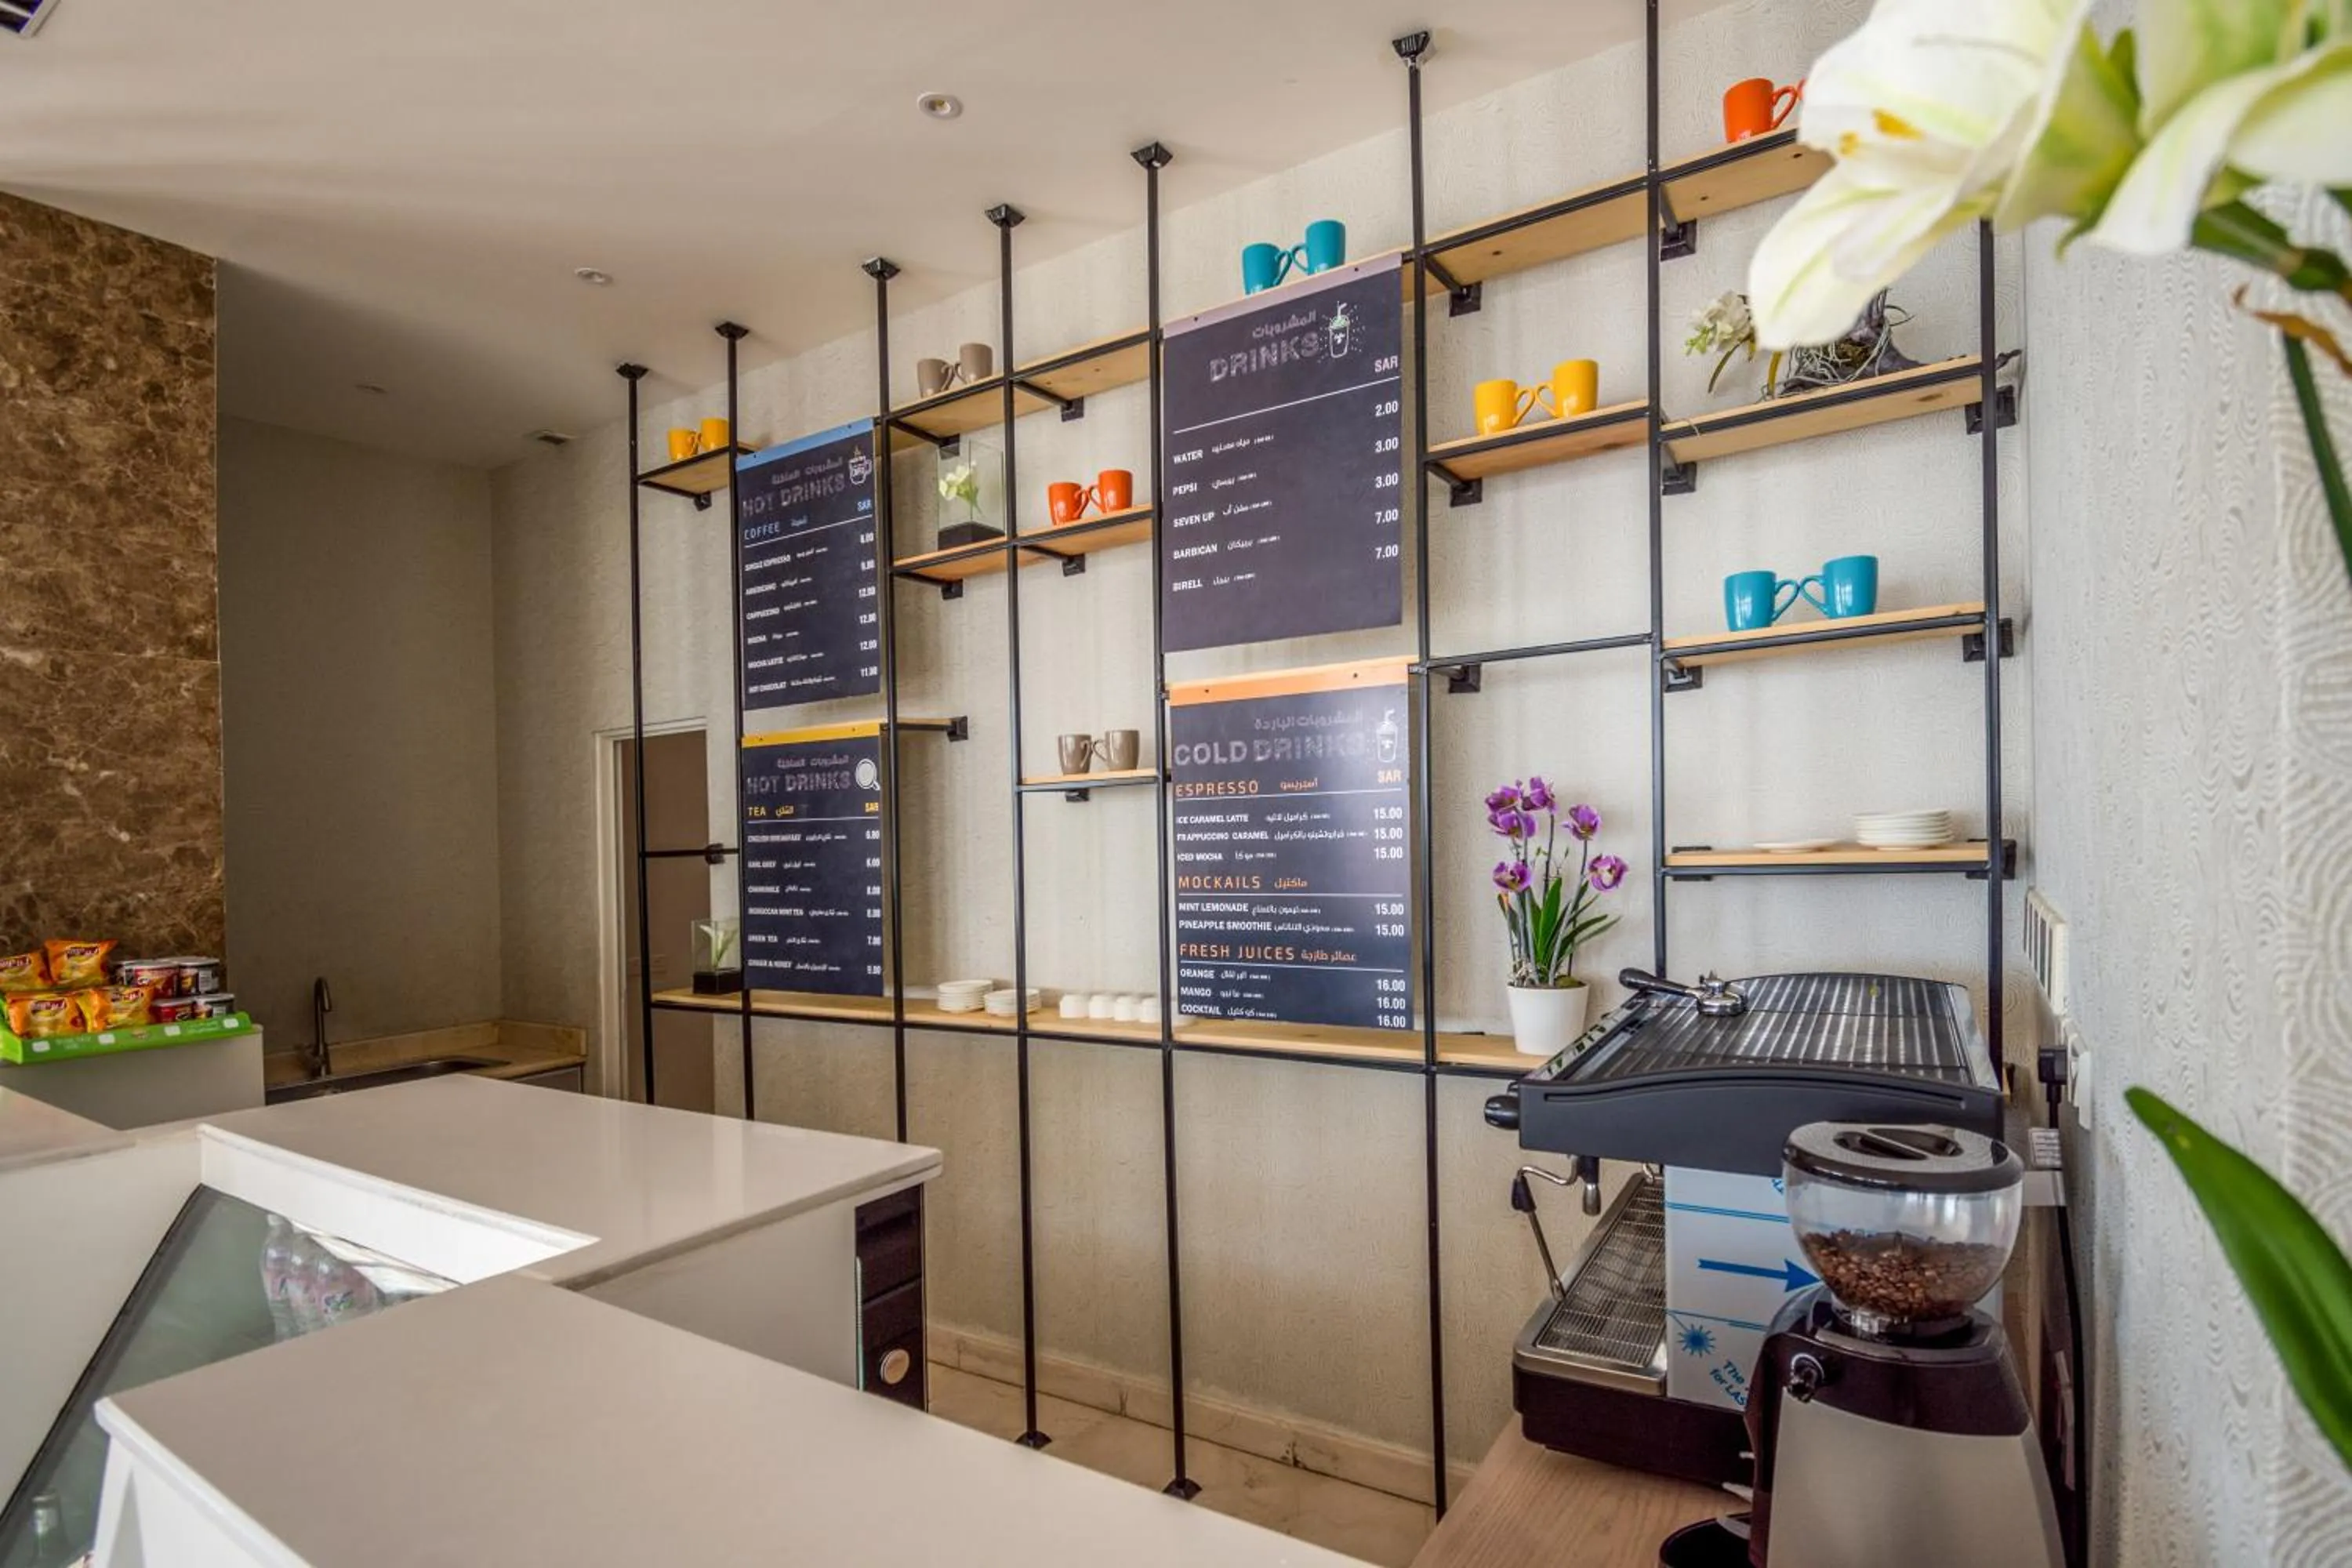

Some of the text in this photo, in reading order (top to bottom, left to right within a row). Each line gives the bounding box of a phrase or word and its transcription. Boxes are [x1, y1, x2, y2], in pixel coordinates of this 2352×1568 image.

[1210, 331, 1319, 382] DRINKS
[1375, 355, 1399, 373] SAR
[1375, 401, 1399, 417] 2.00
[1375, 437, 1399, 454] 3.00
[1174, 449, 1203, 464] WATER
[1375, 473, 1399, 489] 3.00
[743, 473, 846, 517] HOT DRINKS
[1173, 482, 1197, 495] PEPSI
[1173, 511, 1215, 528] SEVEN UP
[1375, 510, 1399, 524] 7.00
[745, 521, 780, 540] COFFEE
[1173, 544, 1218, 560] BARBICAN
[1375, 545, 1399, 559] 7.00
[1173, 579, 1203, 592] BIRELL
[1174, 731, 1367, 766] COLD DRINKS
[747, 771, 851, 794] HOT DRINKS
[1377, 770, 1402, 784] SAR
[1176, 780, 1259, 797] ESPRESSO
[748, 806, 766, 817] TEA
[1189, 814, 1225, 823] CARAMEL
[1226, 814, 1249, 822] LATTE
[1373, 808, 1403, 820] 15.00
[1232, 831, 1269, 840] CARAMEL
[1374, 827, 1403, 840] 15.00
[1196, 852, 1223, 861] MOCHA
[1374, 847, 1403, 859] 15.00
[1178, 876, 1261, 889] MOCKAILS
[1178, 902, 1249, 913] MINT LEMONADE
[1375, 903, 1404, 916] 15.00
[1178, 920, 1272, 931] PINEAPPLE SMOOTHIE
[1375, 924, 1404, 936] 15.00
[1179, 943, 1295, 960] FRESH JUICES
[1180, 968, 1215, 979] ORANGE
[1180, 986, 1211, 997] MANGO
[1376, 978, 1406, 992] 16.00
[1181, 1004, 1221, 1015] COCKTAIL
[1377, 997, 1406, 1010] 16.00
[1377, 1015, 1406, 1028] 16.00
[1710, 1369, 1728, 1385] for
[1724, 1361, 1744, 1384] The
